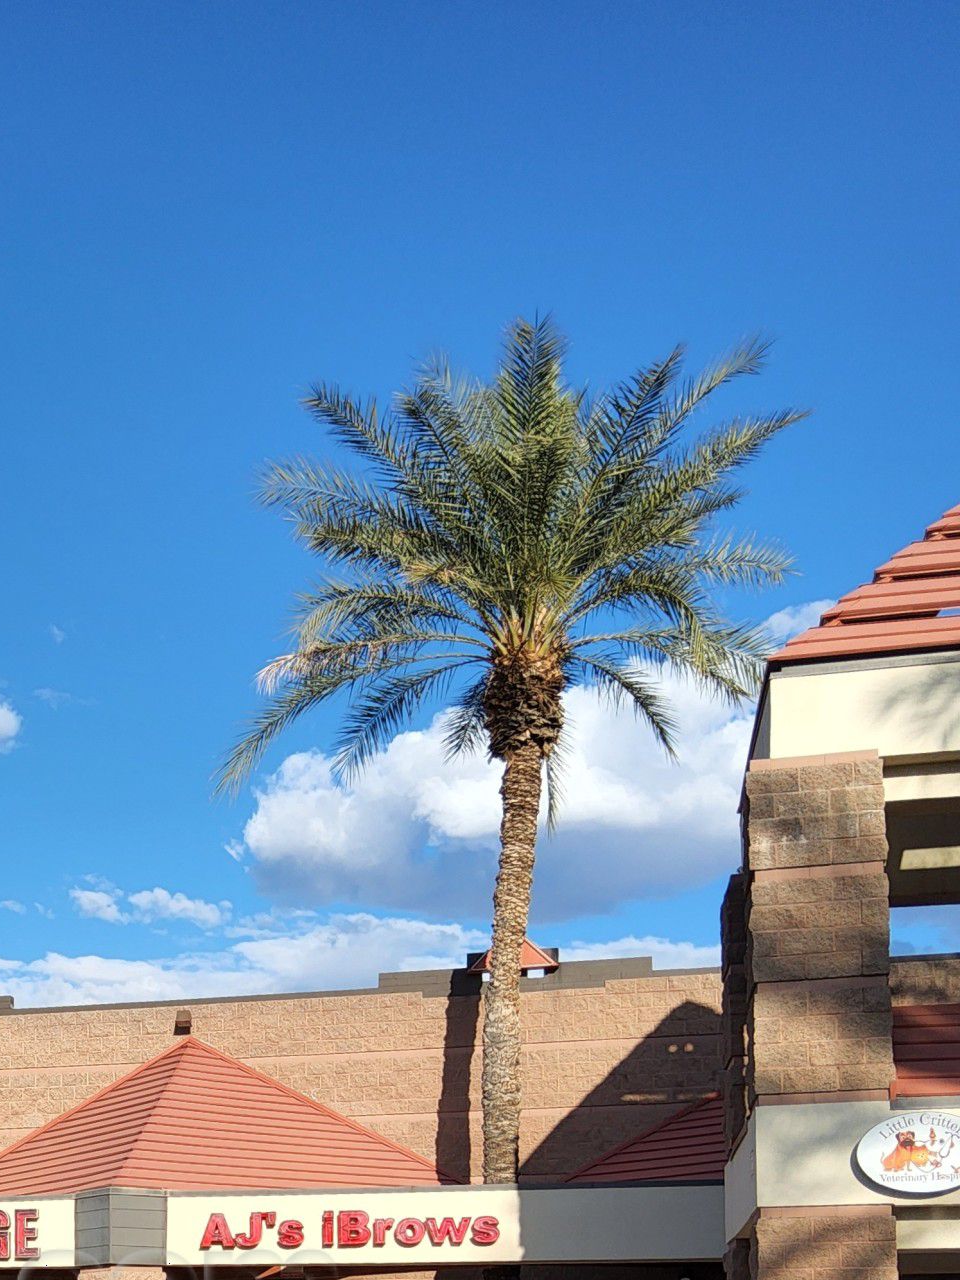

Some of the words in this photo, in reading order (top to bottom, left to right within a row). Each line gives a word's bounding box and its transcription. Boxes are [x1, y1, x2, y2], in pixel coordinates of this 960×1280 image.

[880, 1117, 915, 1139] Little
[920, 1113, 960, 1135] Critte
[880, 1171, 928, 1184] Veterinary
[199, 1211, 305, 1250] AJ's
[322, 1210, 501, 1248] iBrows
